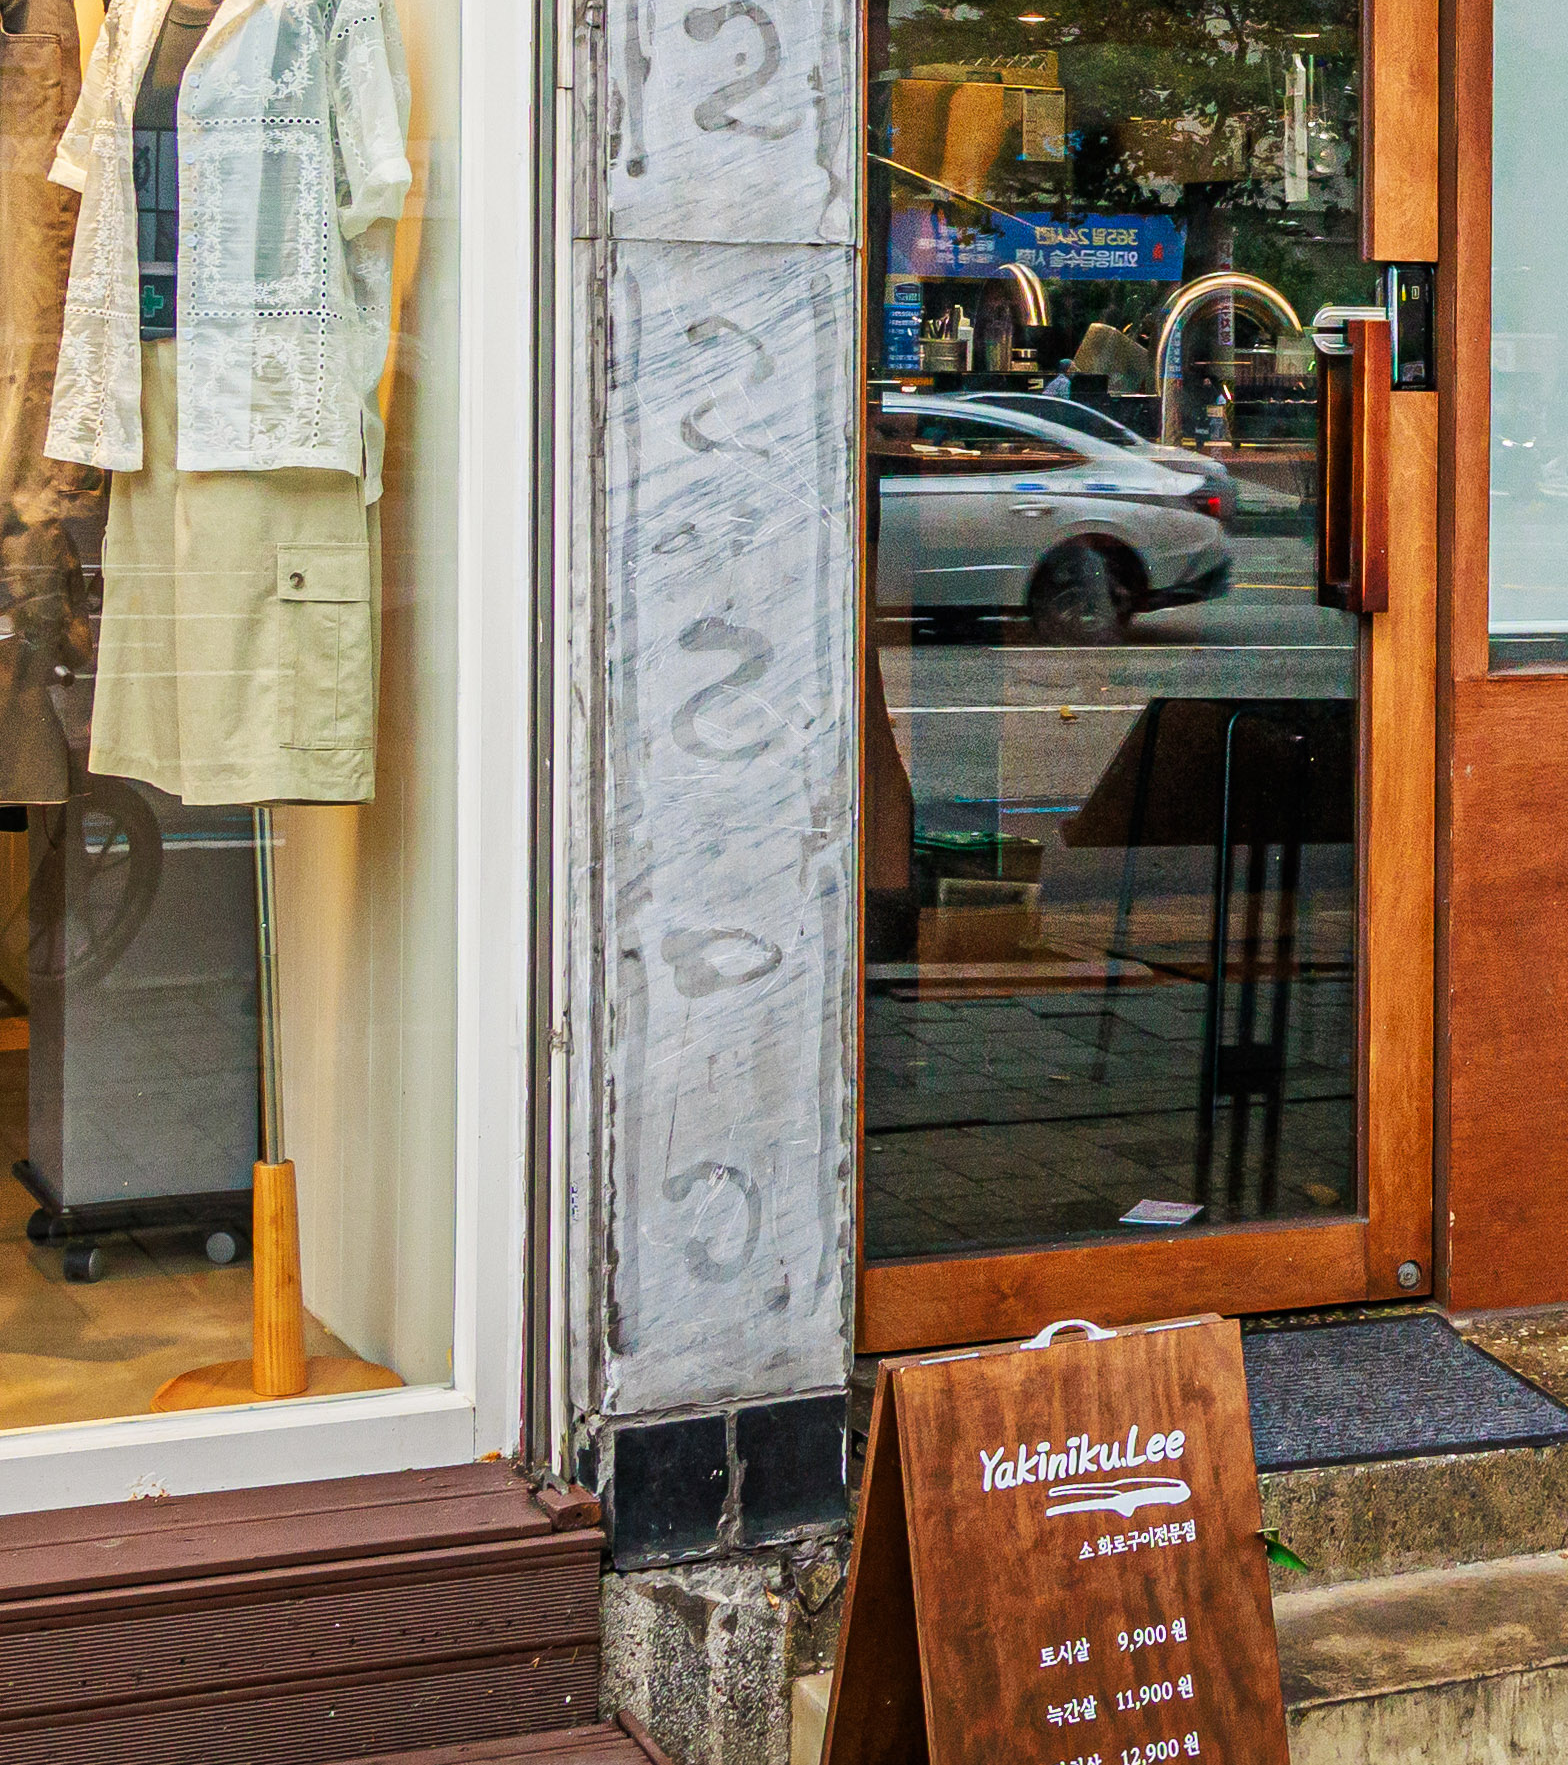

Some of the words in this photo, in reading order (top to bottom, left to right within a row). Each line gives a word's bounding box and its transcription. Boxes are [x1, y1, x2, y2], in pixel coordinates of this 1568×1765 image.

[979, 1424, 1186, 1492] Yakiniku.Lee
[1078, 1542, 1094, 1560] 소
[1097, 1519, 1197, 1557] 화로구이전문점
[1040, 1637, 1090, 1668] 토시살
[1117, 1624, 1167, 1653] 9,900
[1170, 1617, 1188, 1643] 원
[1046, 1694, 1097, 1727] 늑간살
[1116, 1681, 1173, 1711] 11,900
[1177, 1673, 1194, 1700] 원
[1120, 1739, 1180, 1765] 12,900
[1183, 1731, 1200, 1757] 원
